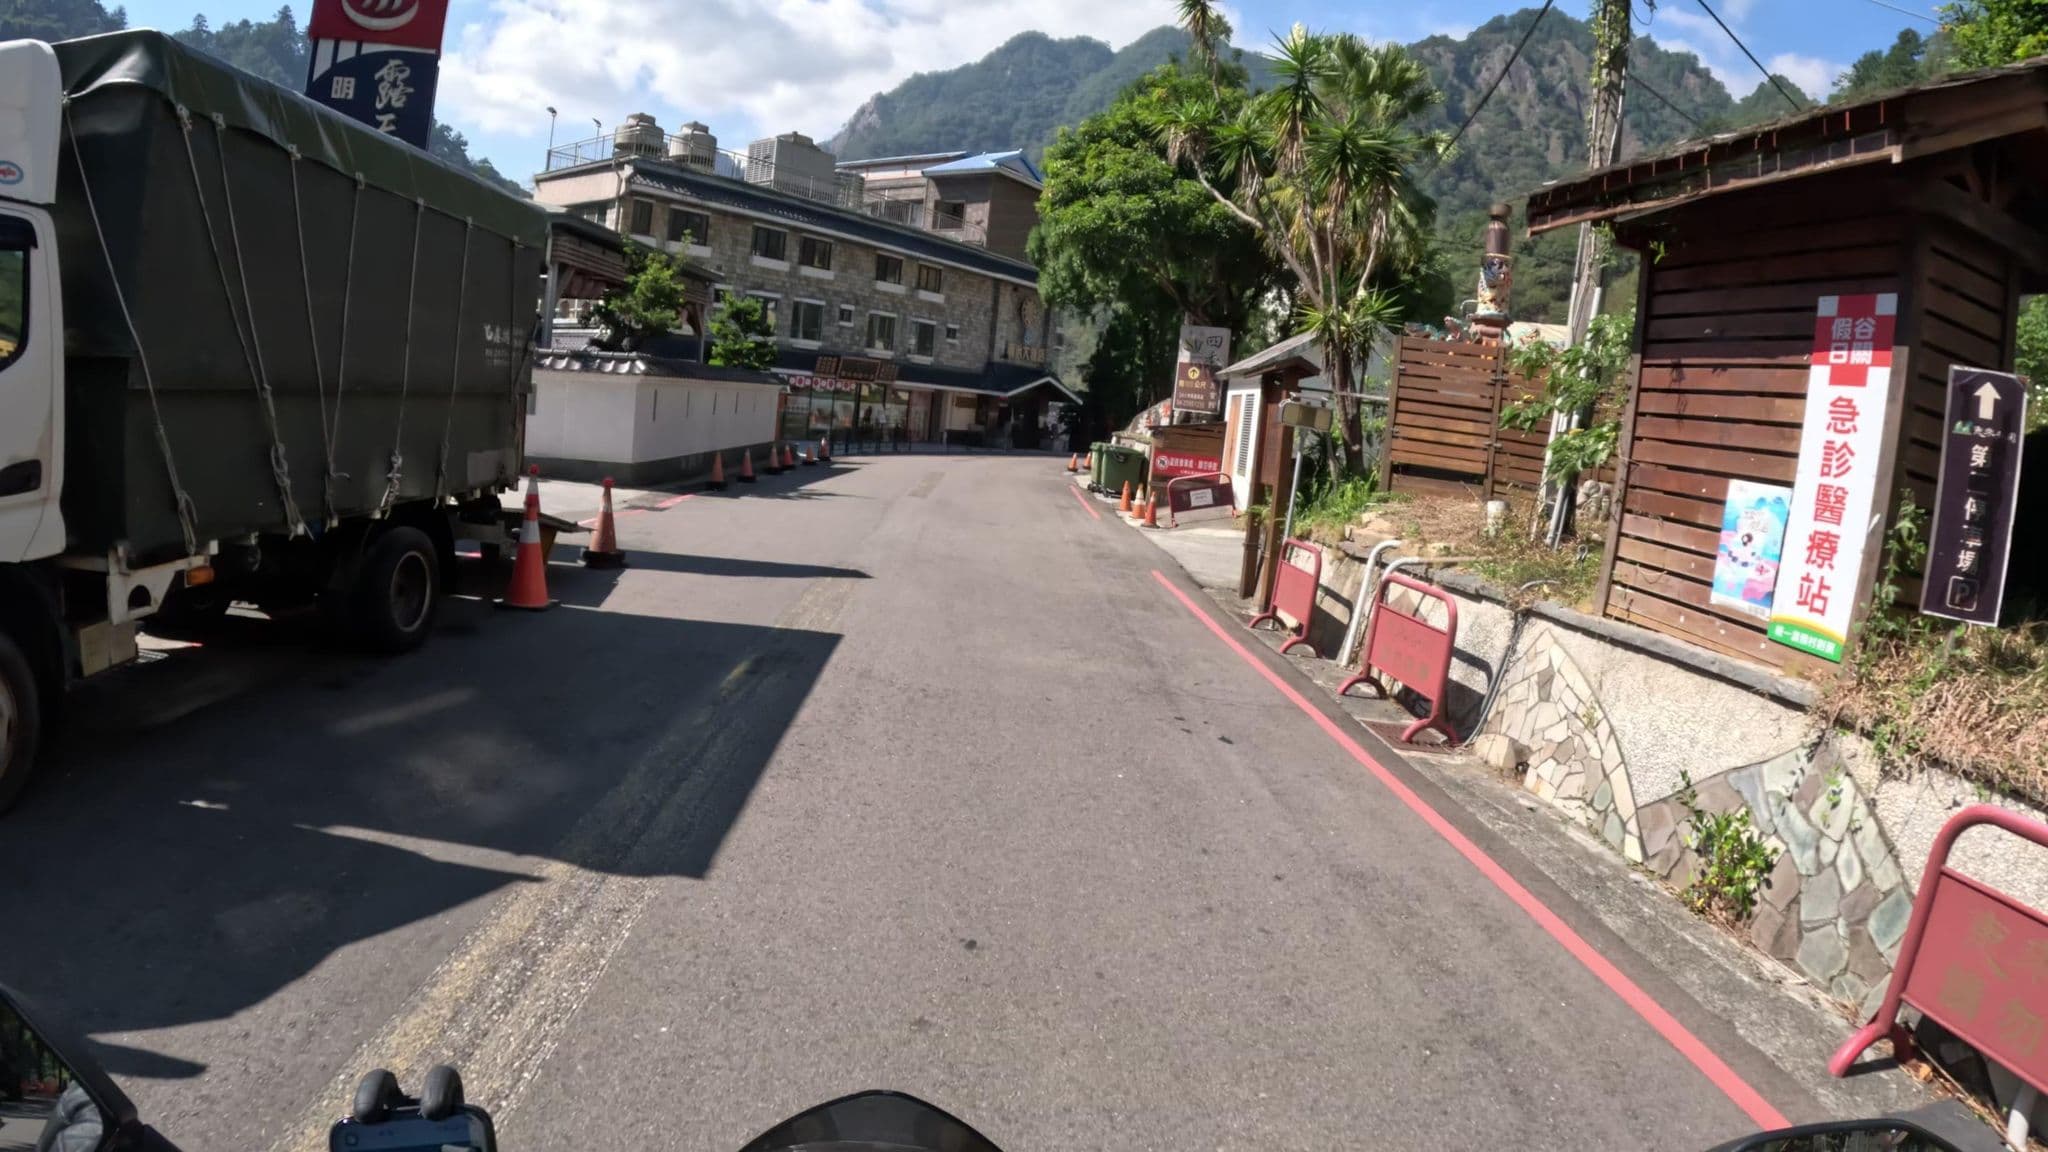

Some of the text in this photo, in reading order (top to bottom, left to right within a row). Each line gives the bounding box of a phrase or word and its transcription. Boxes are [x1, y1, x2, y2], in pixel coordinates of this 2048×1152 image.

[330, 75, 356, 100] 明
[1828, 316, 1854, 364] 假日
[1849, 316, 1877, 365] 谷關
[1796, 395, 1861, 618] 急診醫療站
[1956, 443, 1991, 575] 第二停車場
